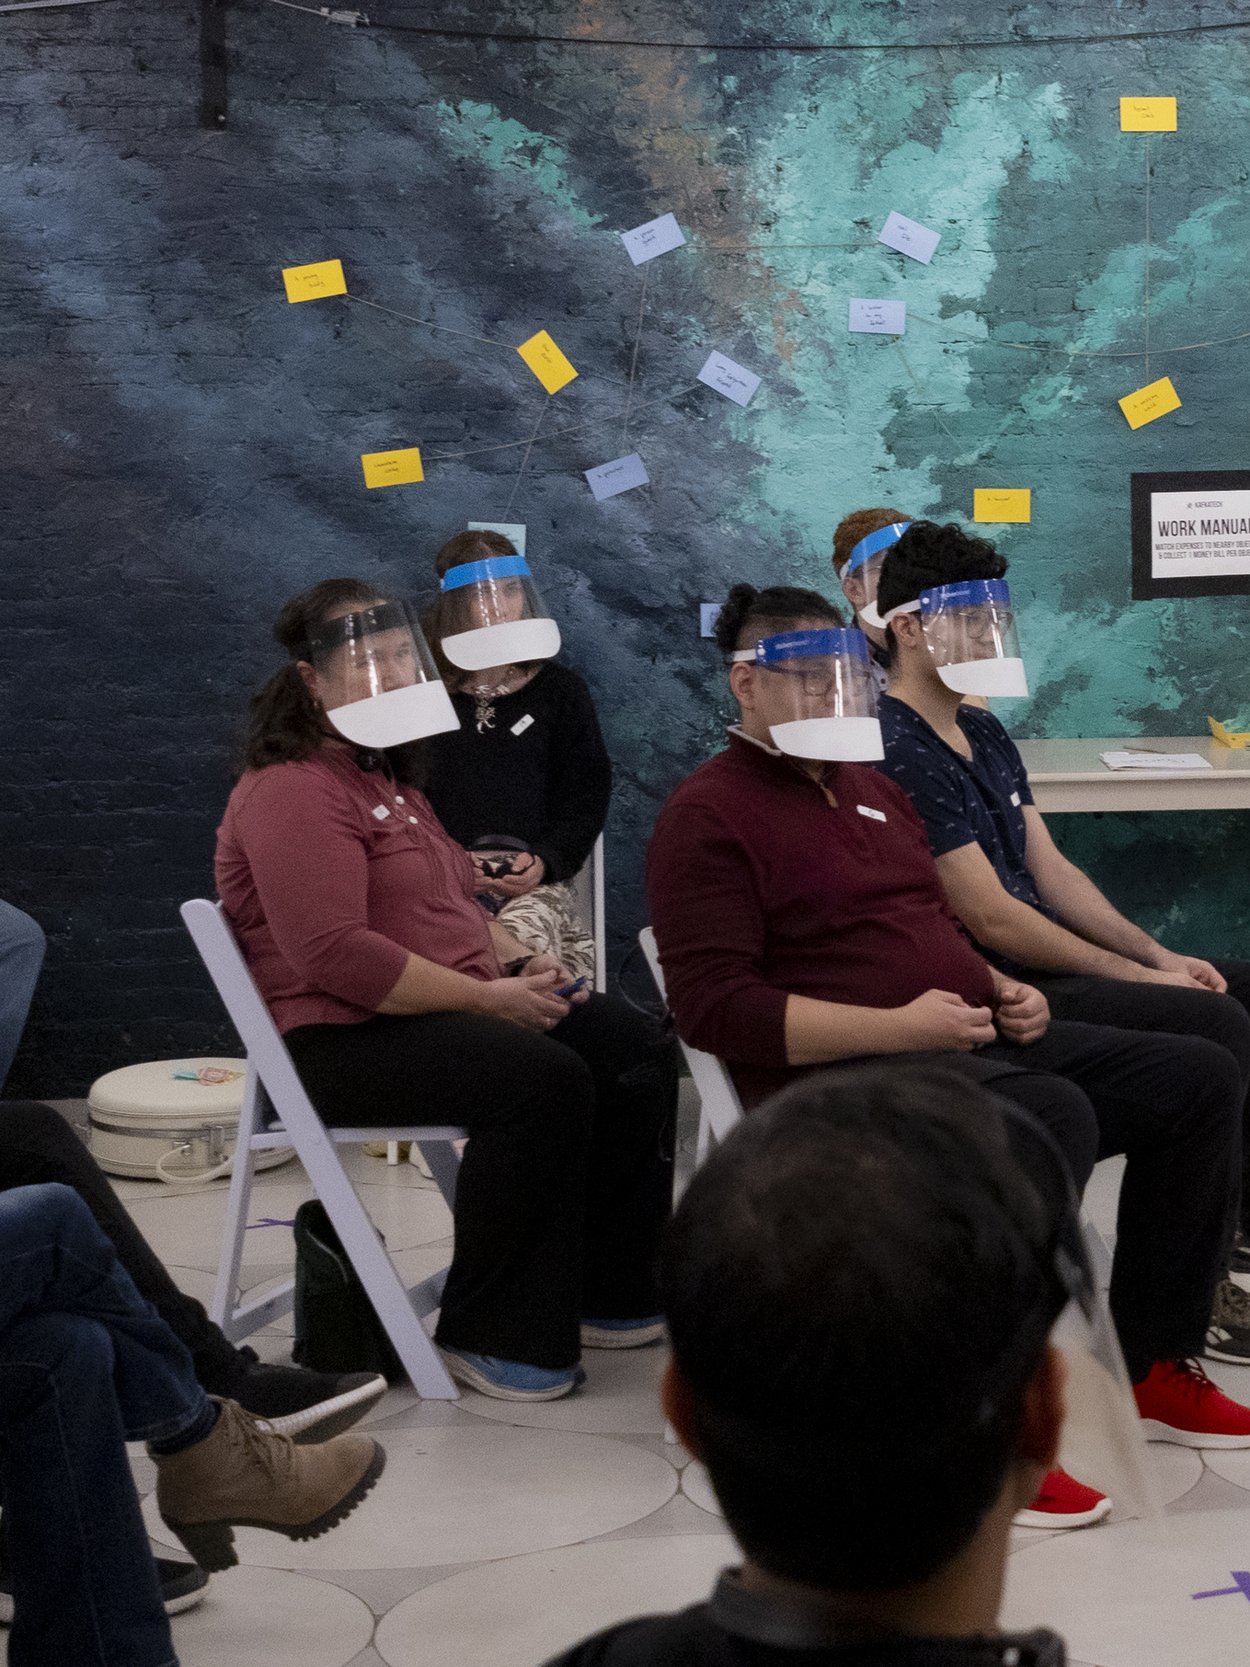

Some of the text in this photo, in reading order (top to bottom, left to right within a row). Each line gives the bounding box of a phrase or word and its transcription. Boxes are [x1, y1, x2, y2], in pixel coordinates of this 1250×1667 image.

[1158, 520, 1197, 537] WORK
[1155, 543, 1175, 551] MATCH
[1176, 542, 1204, 550] EXPENSES
[1205, 541, 1212, 549] TO
[1213, 541, 1235, 549] NEARBY
[1163, 551, 1187, 559] COLLECT
[1193, 551, 1212, 559] MONEY
[1214, 550, 1225, 558] BILL
[1226, 549, 1237, 557] PER
